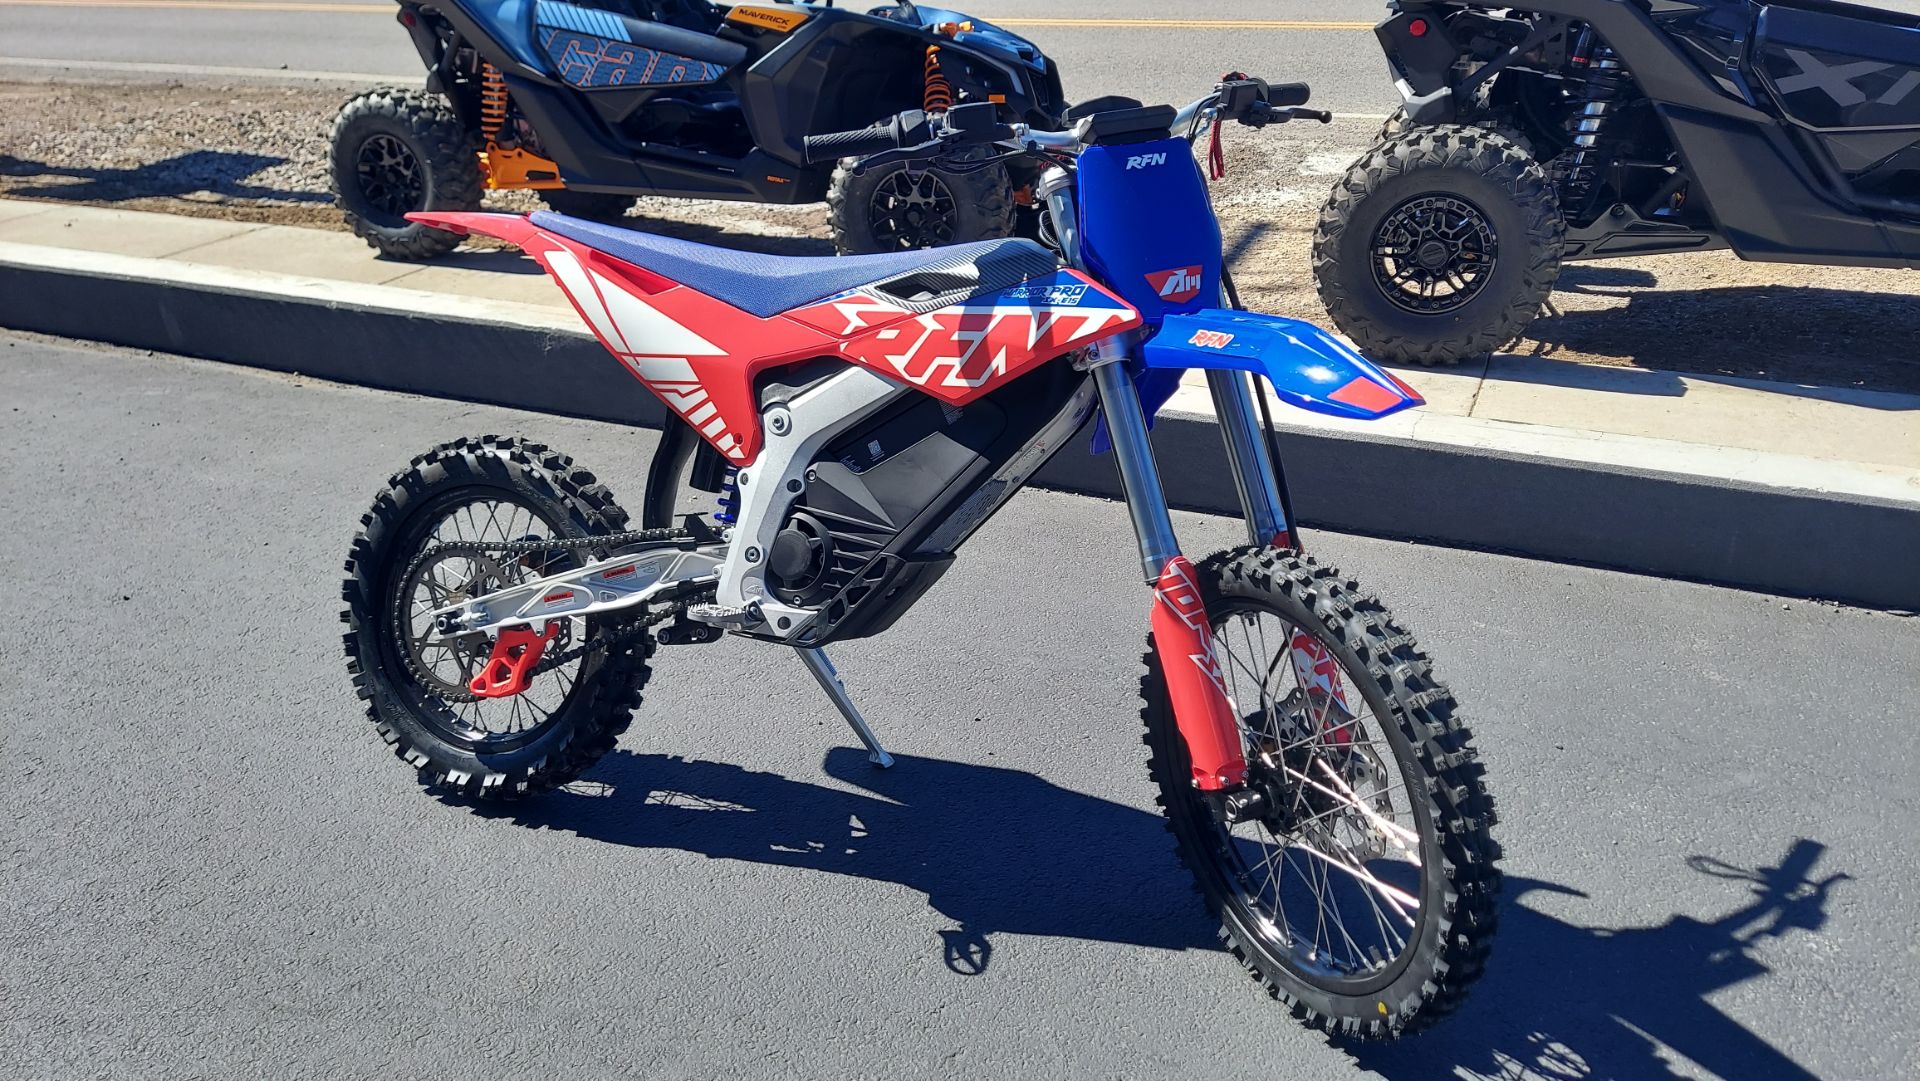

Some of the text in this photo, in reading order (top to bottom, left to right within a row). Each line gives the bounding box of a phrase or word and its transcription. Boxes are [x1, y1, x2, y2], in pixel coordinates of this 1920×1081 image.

[738, 8, 790, 25] MAVERICK
[1126, 153, 1167, 170] RFN
[1049, 284, 1087, 298] PRO
[1188, 329, 1234, 349] RFN
